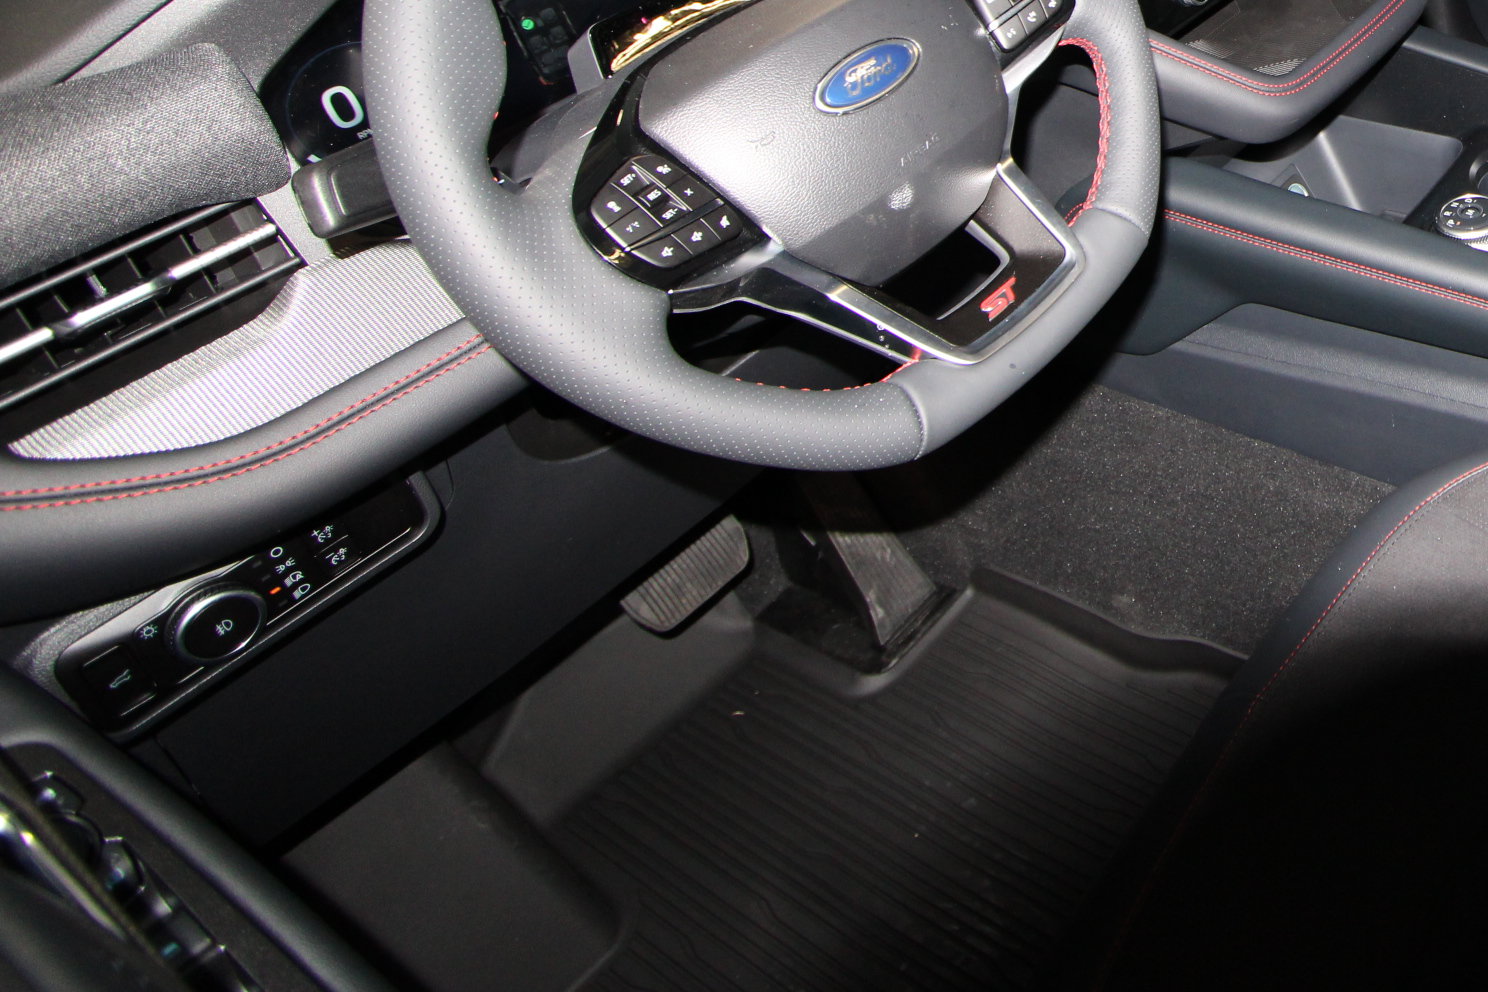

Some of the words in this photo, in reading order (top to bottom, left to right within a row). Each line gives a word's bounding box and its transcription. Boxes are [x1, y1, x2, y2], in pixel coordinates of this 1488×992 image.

[321, 85, 365, 129] 0
[646, 189, 662, 201] RES
[980, 276, 1017, 322] ST
